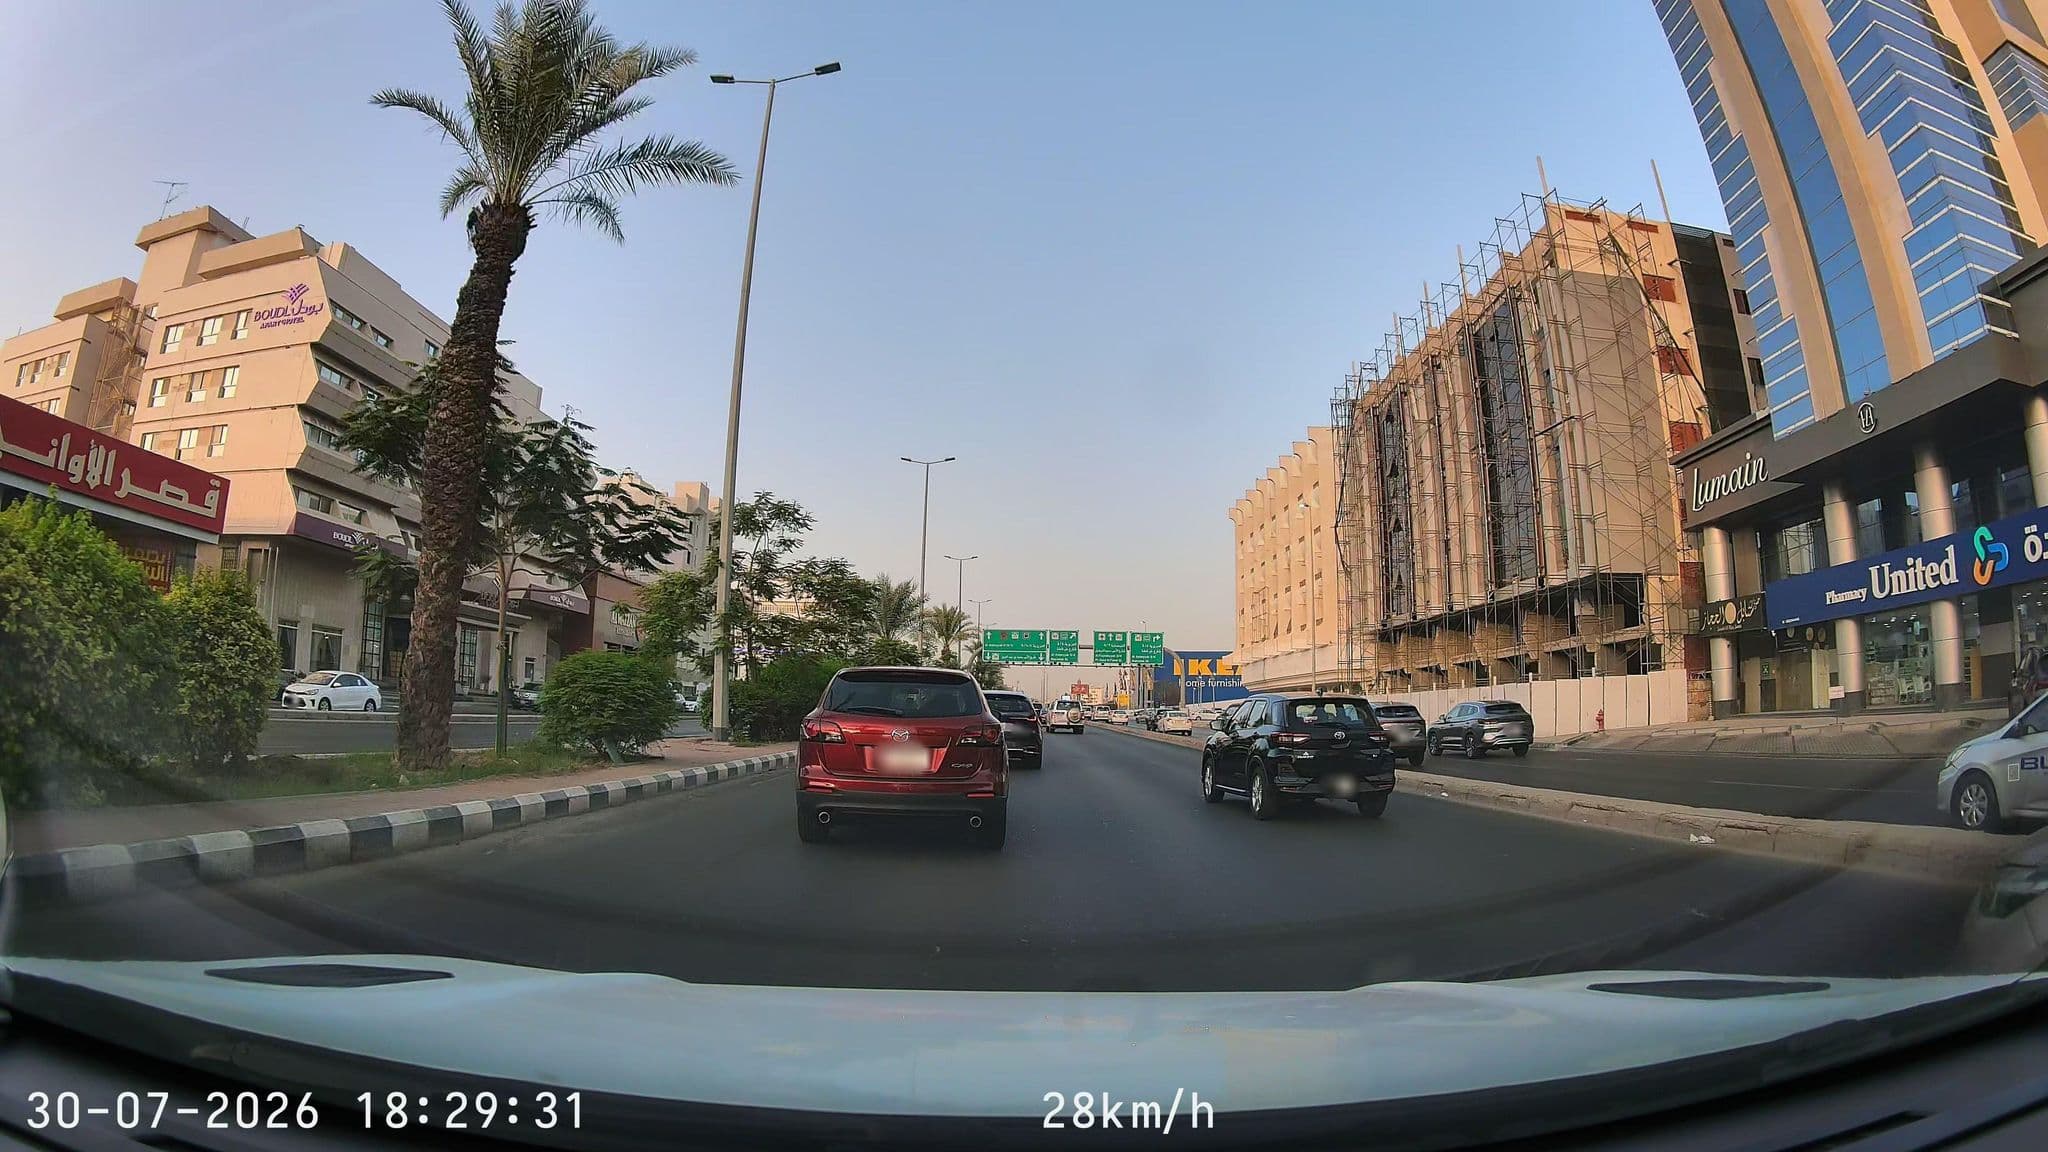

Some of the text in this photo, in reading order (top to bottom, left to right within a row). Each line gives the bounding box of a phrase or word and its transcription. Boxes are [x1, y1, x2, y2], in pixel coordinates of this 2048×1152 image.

[254, 305, 291, 322] BOUDL
[114, 467, 220, 519] قصر
[1692, 452, 1769, 512] Lumain
[1825, 544, 1960, 605] Pharmacy United
